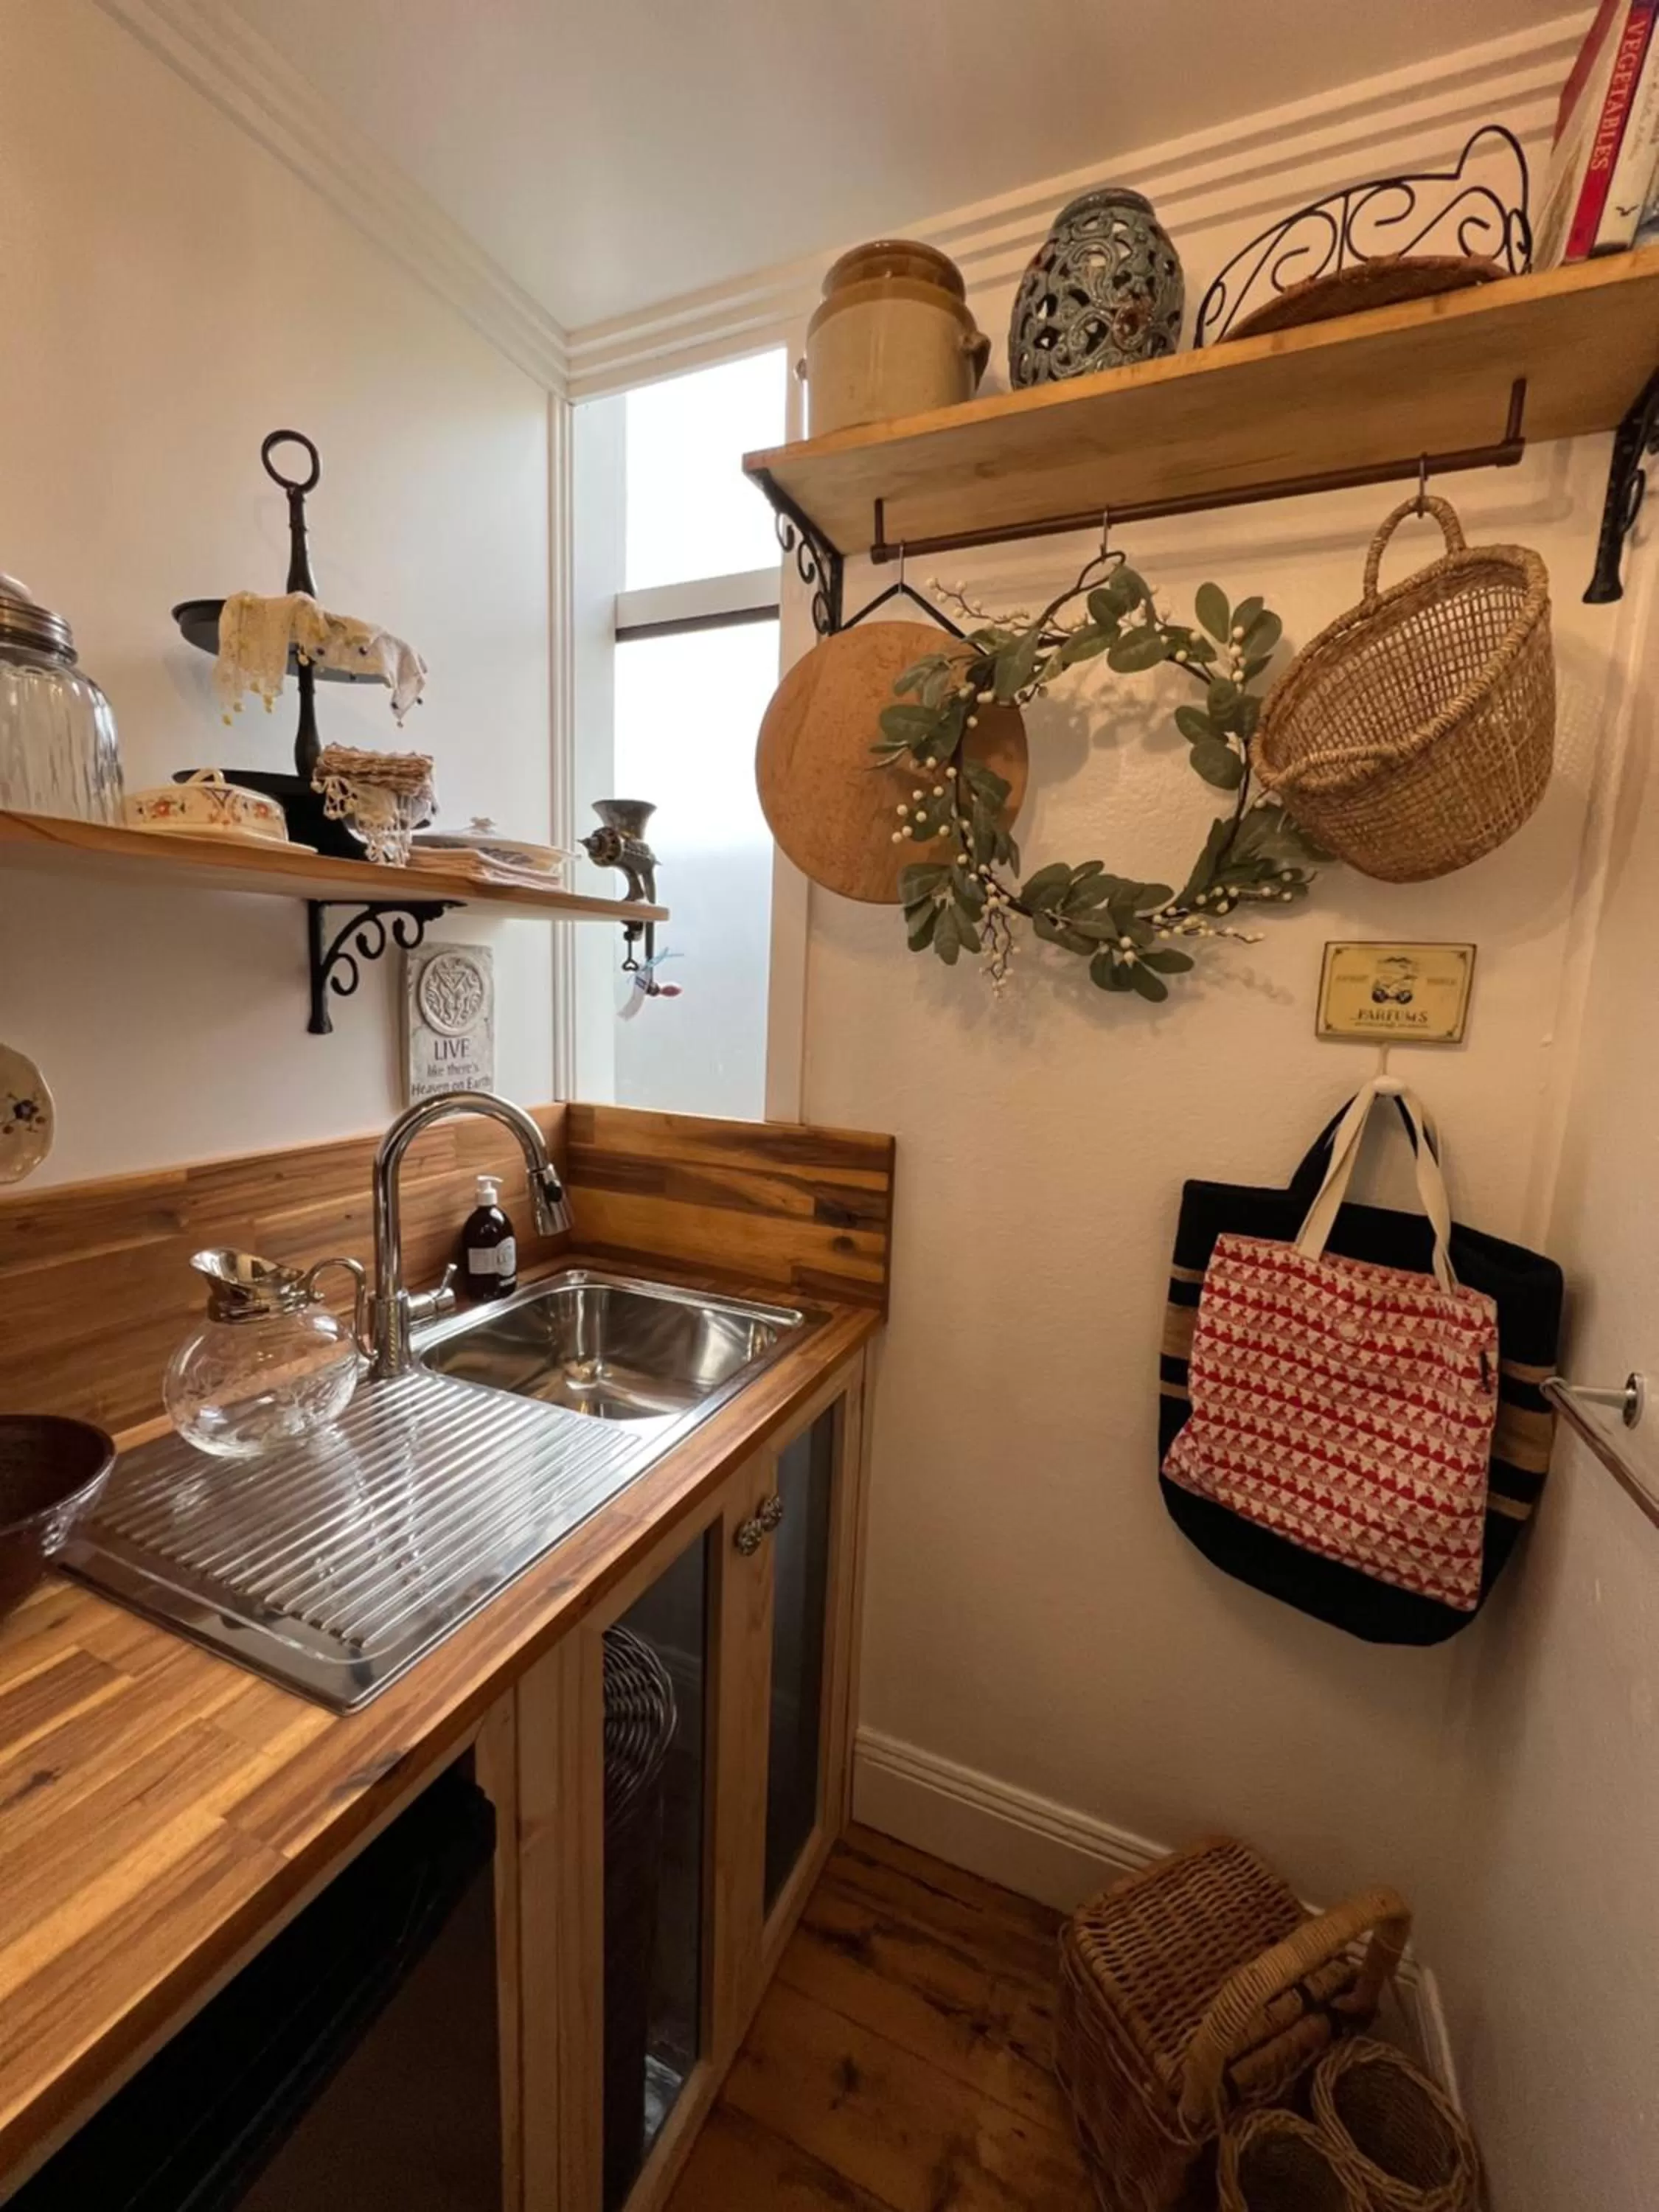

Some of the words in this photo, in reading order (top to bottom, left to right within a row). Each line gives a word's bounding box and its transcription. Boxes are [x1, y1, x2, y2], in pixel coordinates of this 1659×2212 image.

[1590, 19, 1646, 171] VEGETABLES
[1357, 1008, 1429, 1023] PARFUMS
[434, 1037, 472, 1061] LIVE
